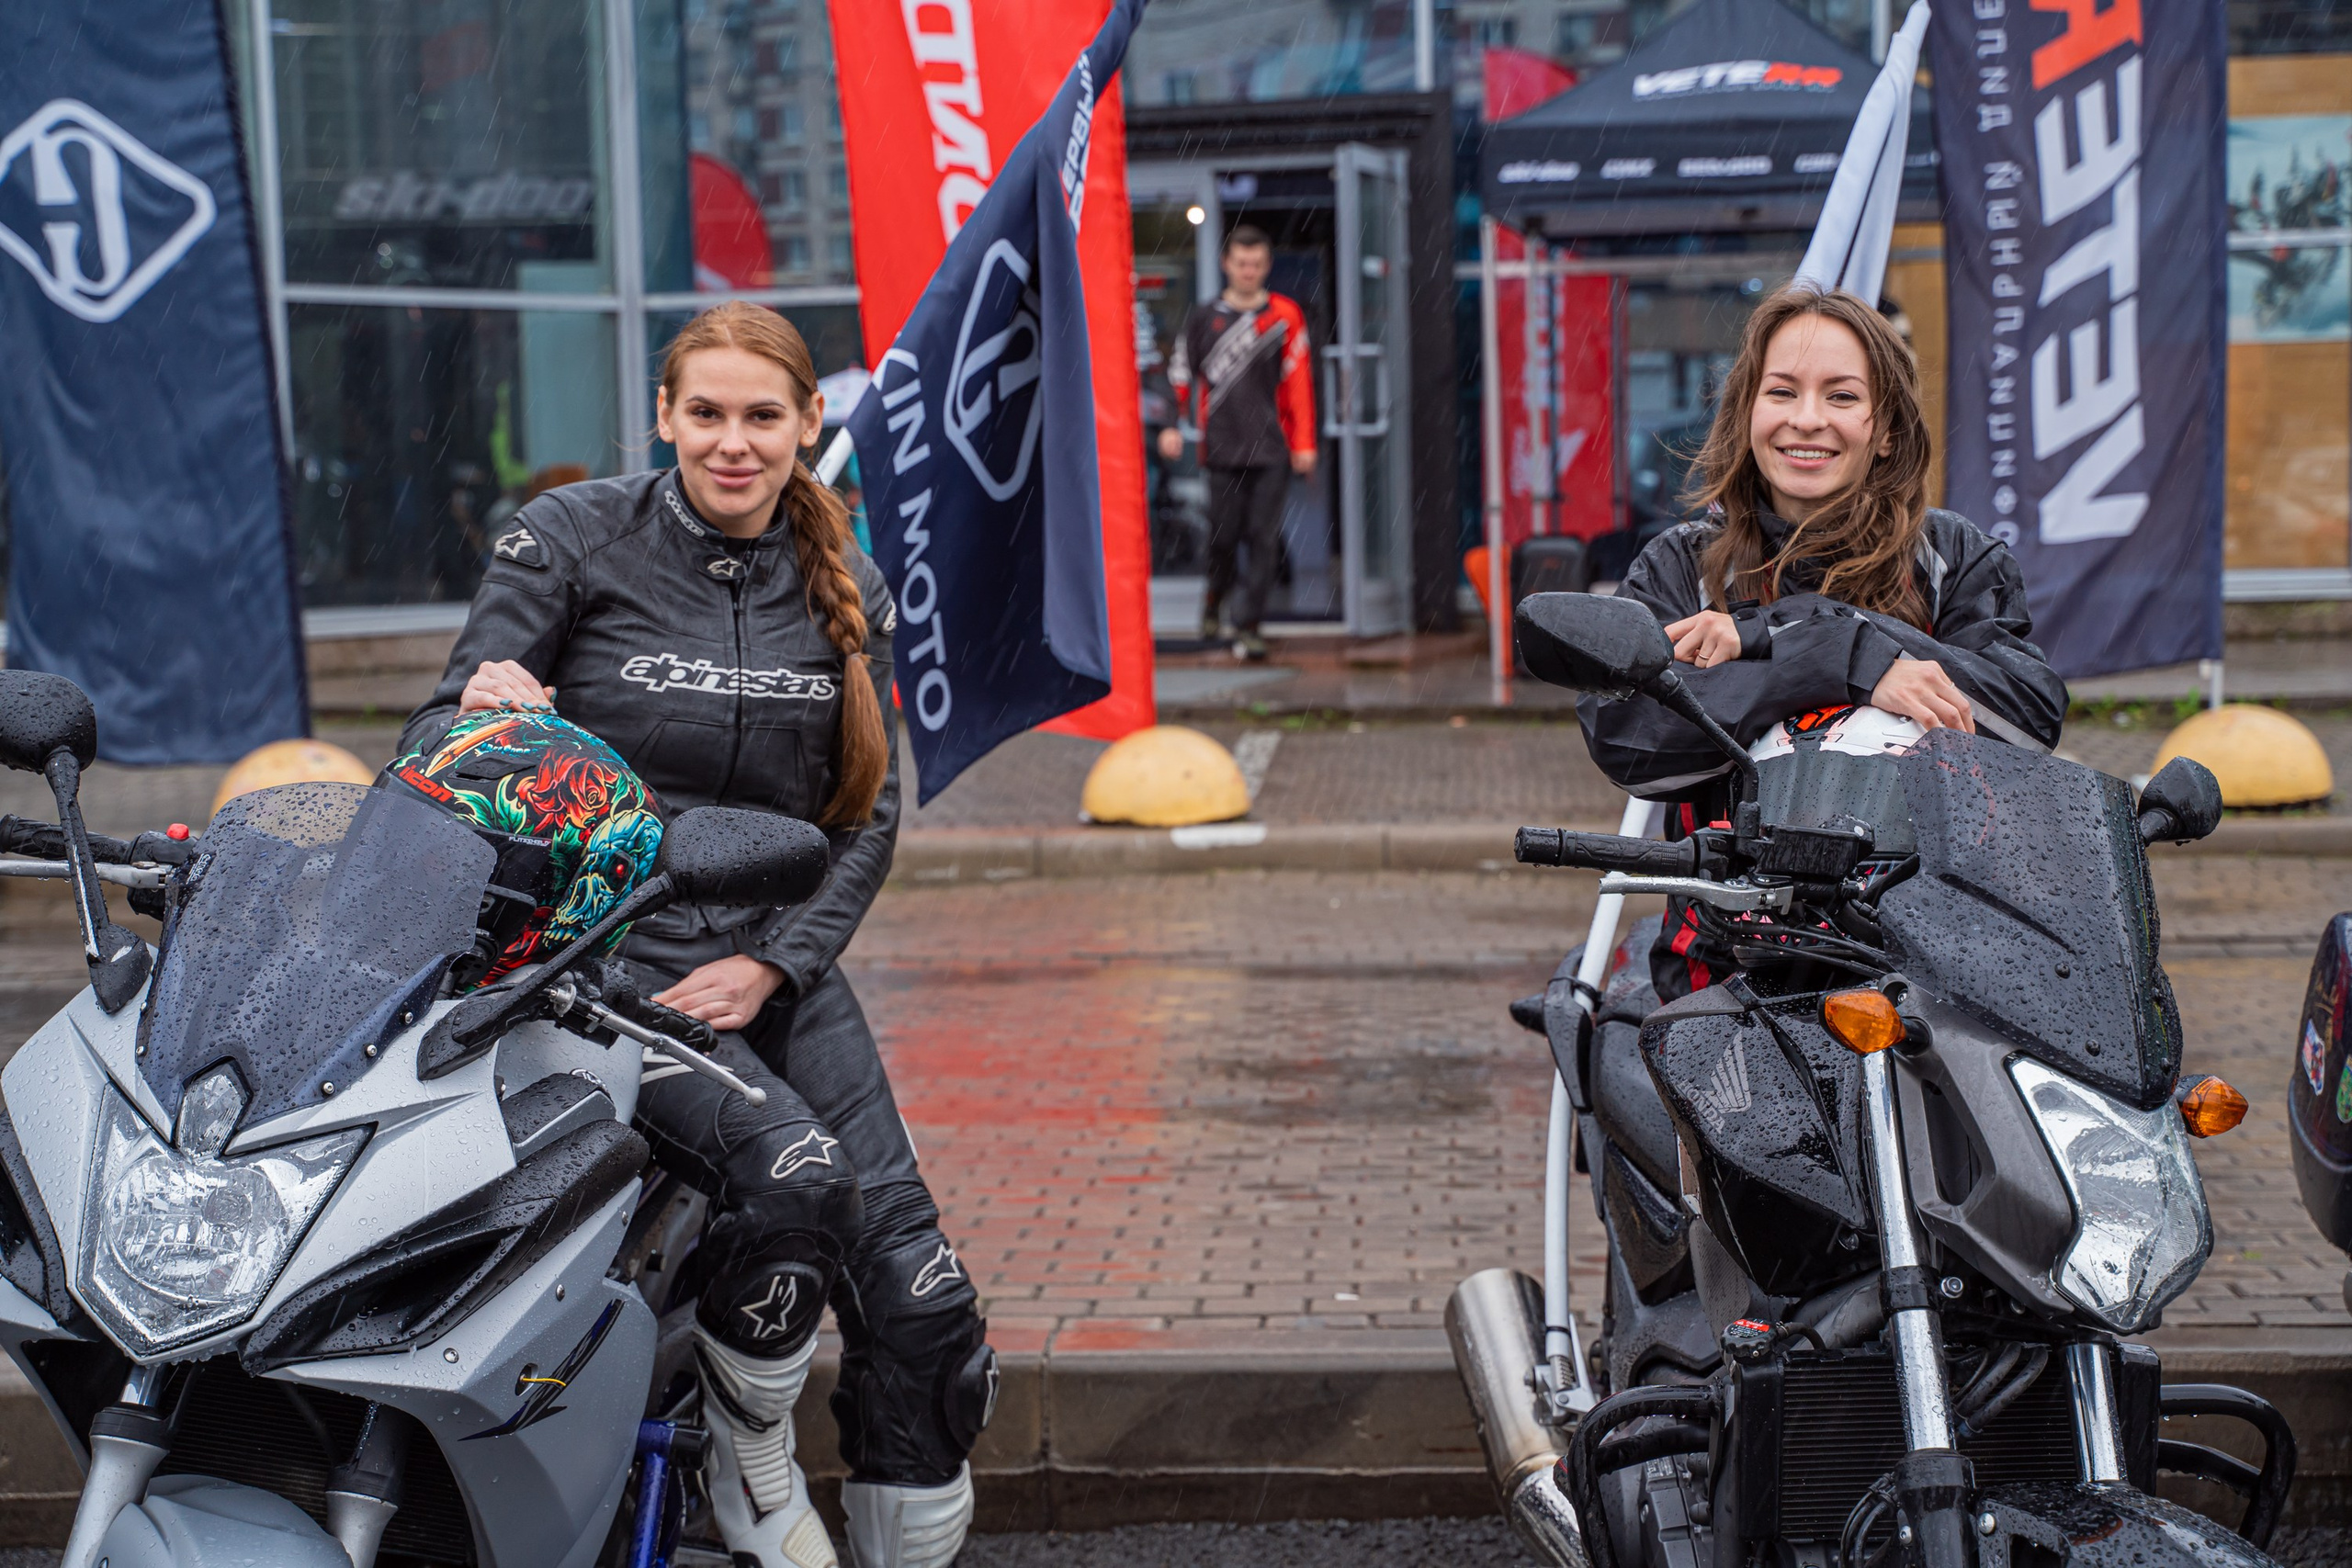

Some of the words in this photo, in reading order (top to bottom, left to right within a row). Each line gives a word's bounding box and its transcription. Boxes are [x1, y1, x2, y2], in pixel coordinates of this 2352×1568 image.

[899, 487, 953, 732] MOTO
[620, 652, 836, 701] alpinestars
[1674, 1078, 1726, 1135] HONDA
